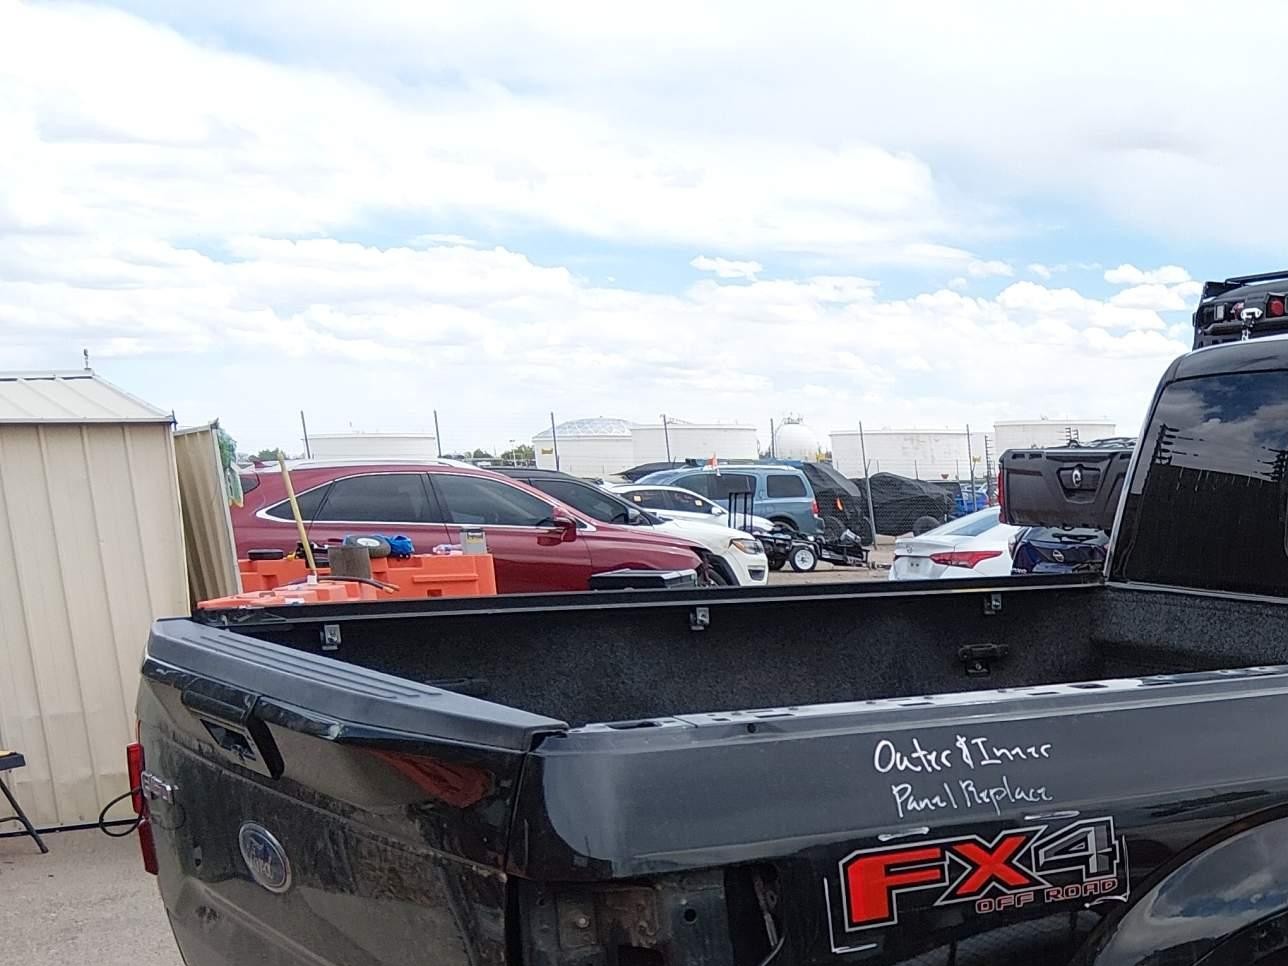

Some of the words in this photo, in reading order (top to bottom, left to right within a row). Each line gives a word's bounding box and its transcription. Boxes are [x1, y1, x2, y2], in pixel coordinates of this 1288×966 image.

[892, 783, 957, 818] Panel
[959, 776, 1053, 816] Replace
[839, 817, 1119, 932] FX4
[975, 892, 1035, 914] OFF
[1044, 878, 1119, 904] ROAD
